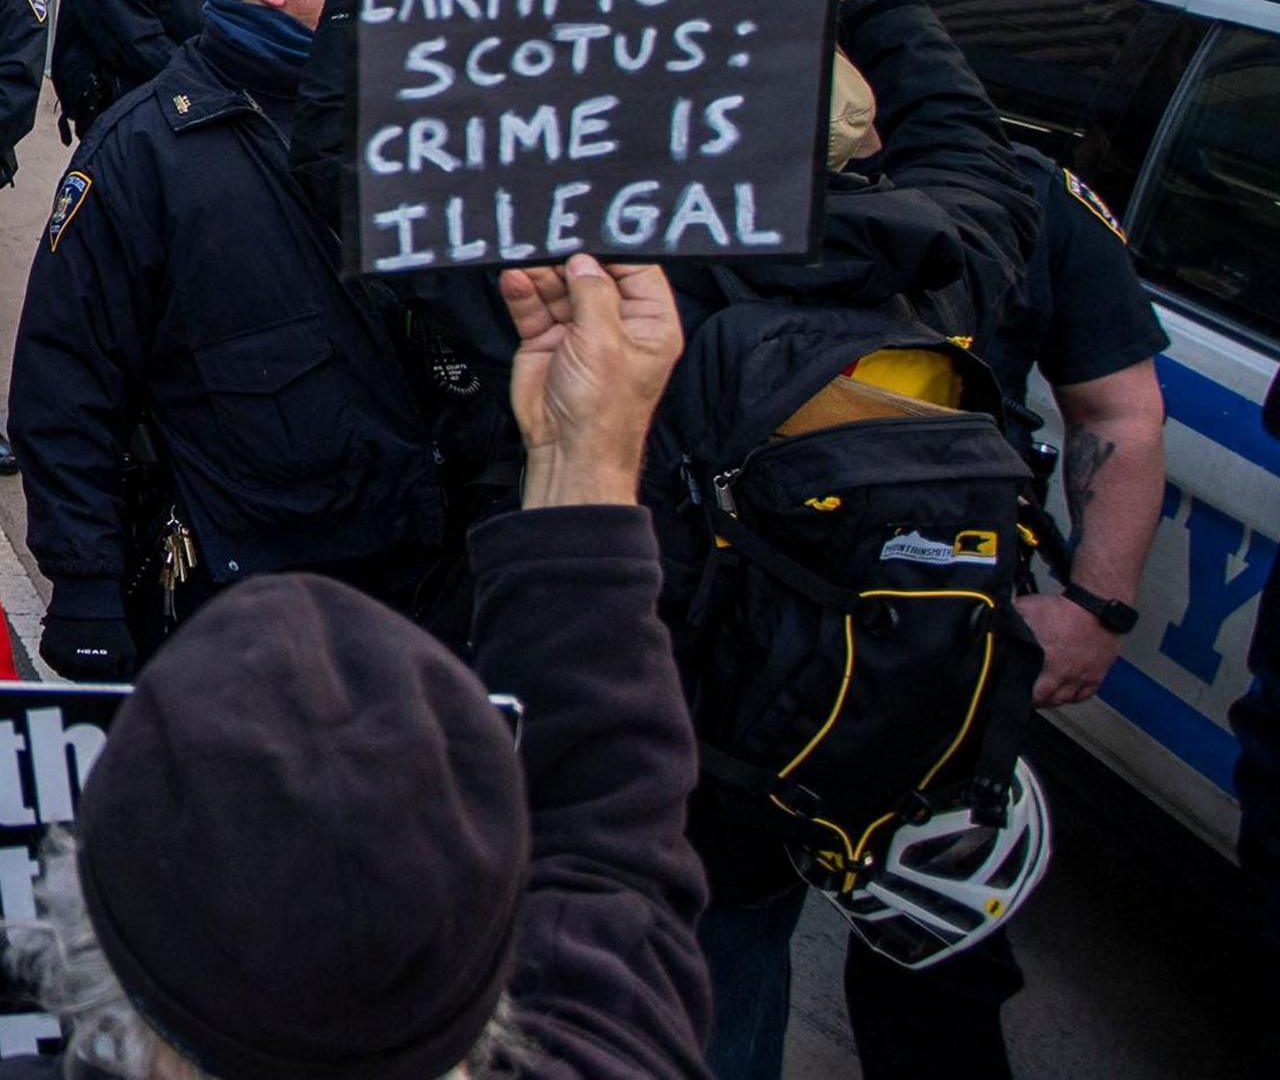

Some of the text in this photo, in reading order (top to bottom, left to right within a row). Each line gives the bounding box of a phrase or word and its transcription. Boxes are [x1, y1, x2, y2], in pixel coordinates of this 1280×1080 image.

[397, 20, 757, 100] SCOTUS:
[364, 96, 744, 174] CRIME IS
[372, 181, 782, 272] ILLEGAL
